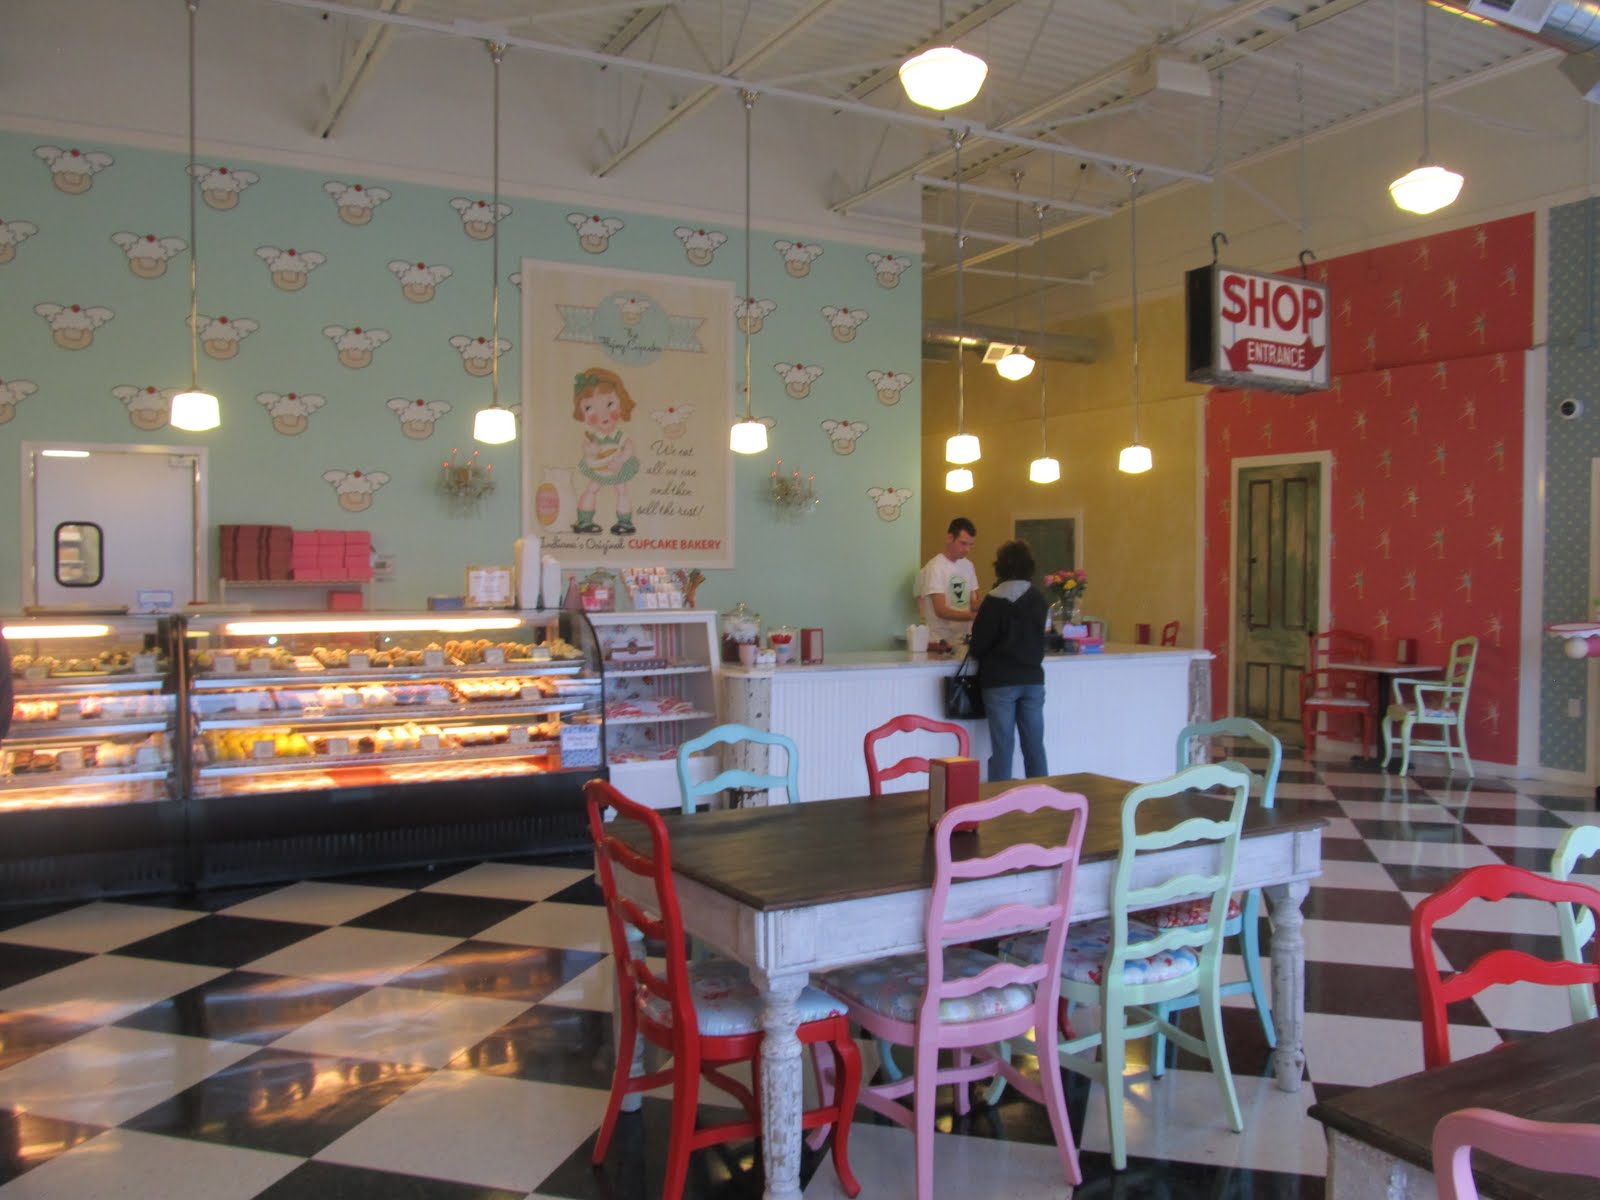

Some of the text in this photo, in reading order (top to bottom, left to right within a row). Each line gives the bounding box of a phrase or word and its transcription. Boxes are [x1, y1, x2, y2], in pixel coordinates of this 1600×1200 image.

[1221, 274, 1324, 334] SHOP
[1246, 341, 1305, 368] ENTRANCE
[650, 439, 676, 456] We
[646, 460, 667, 474] all
[650, 480, 693, 496] and then
[637, 500, 659, 515] sell
[659, 500, 675, 515] the
[585, 537, 625, 555] Original
[628, 538, 678, 550] CUPCAKE
[679, 539, 721, 551] BAKERY
